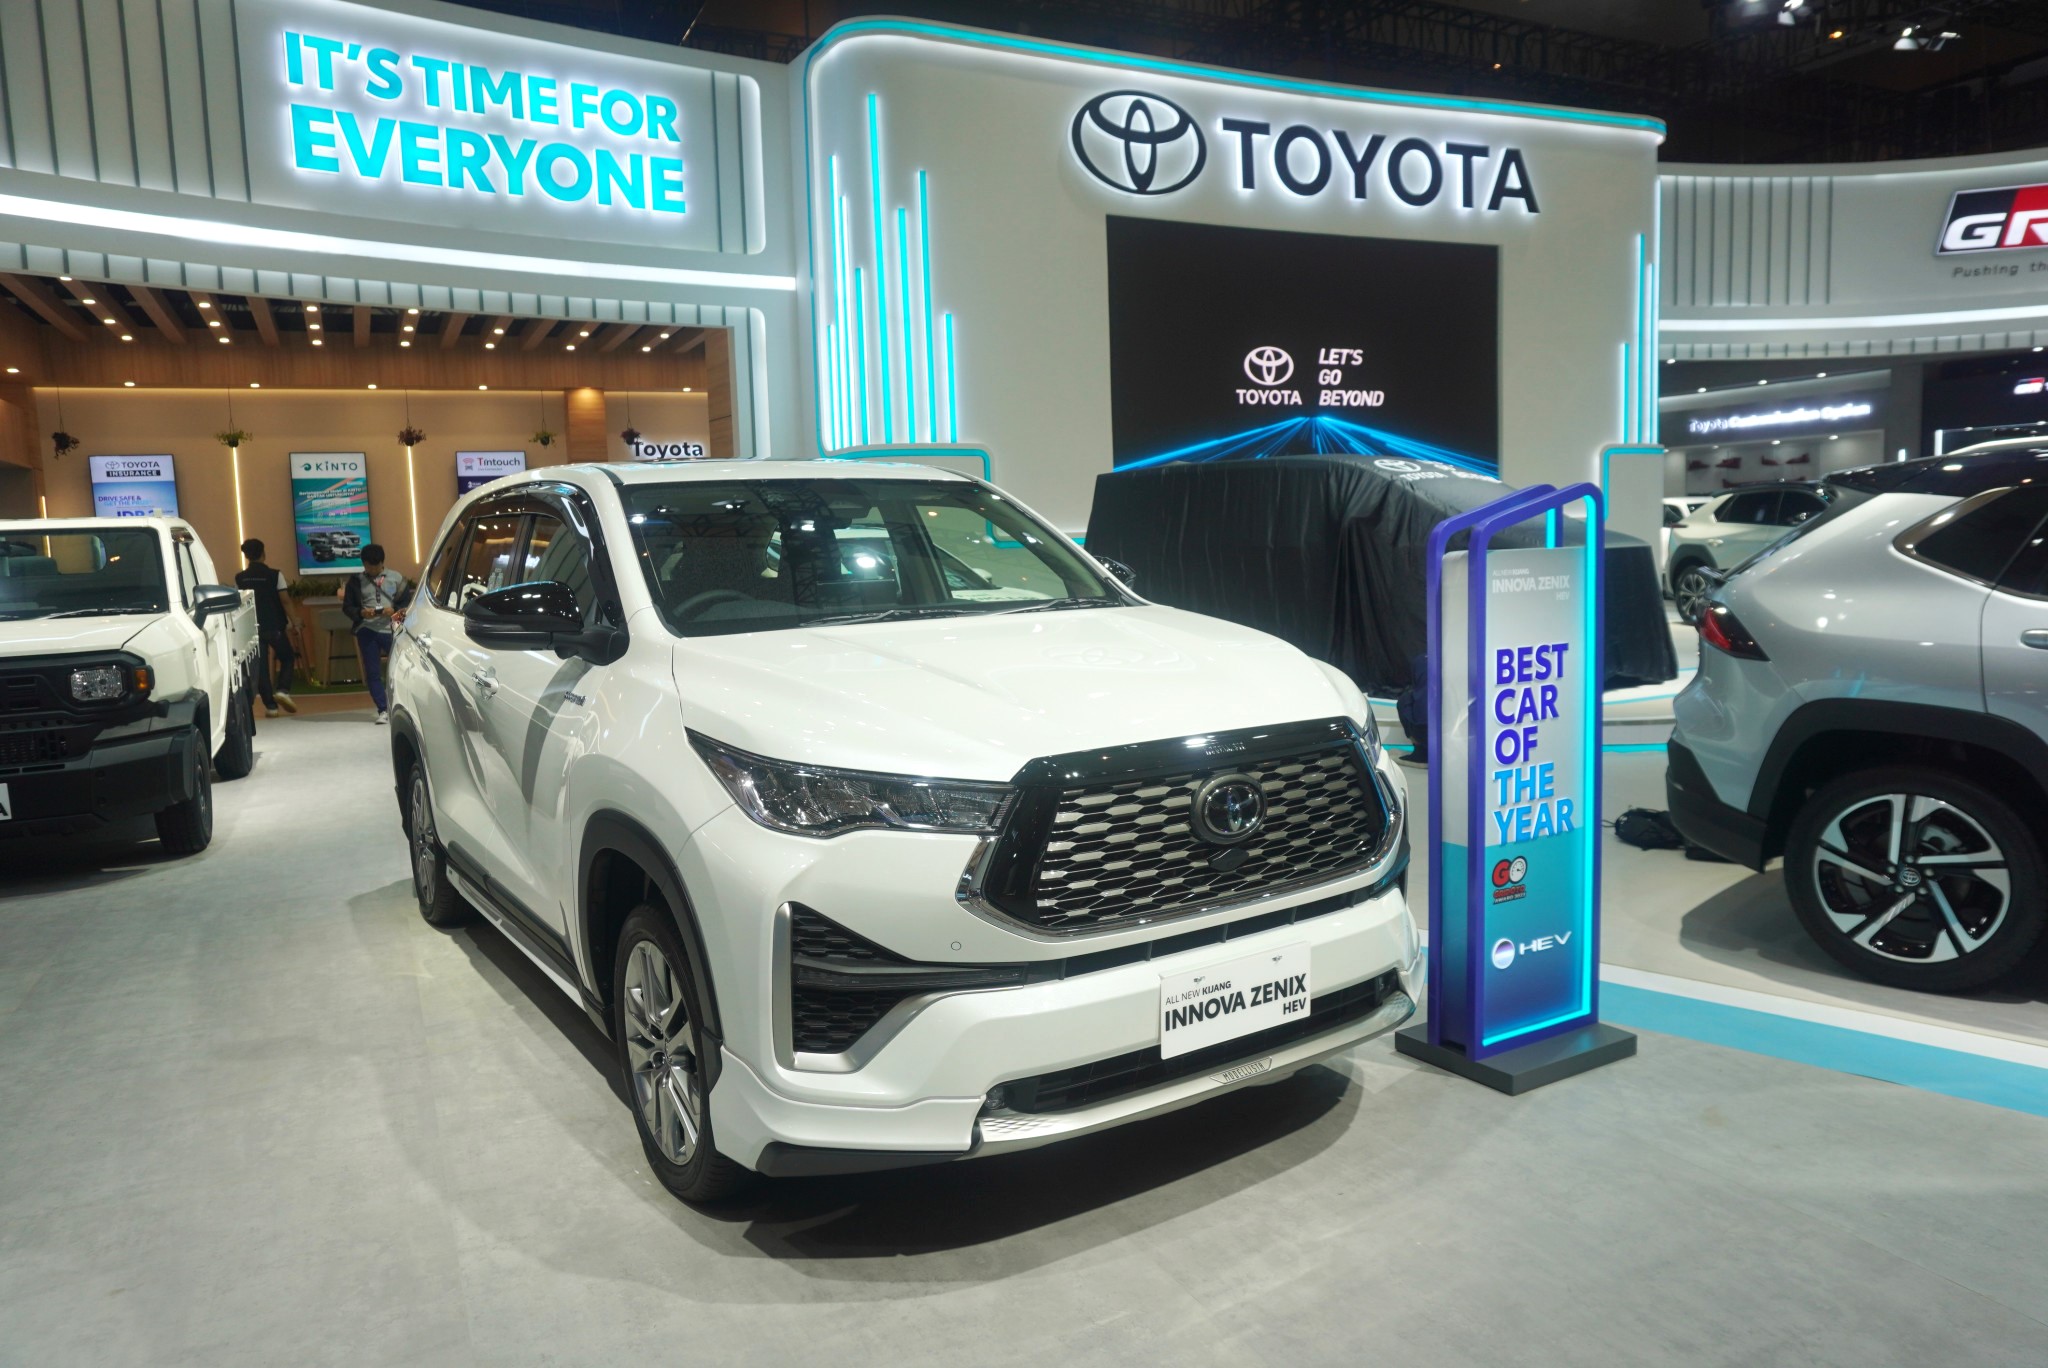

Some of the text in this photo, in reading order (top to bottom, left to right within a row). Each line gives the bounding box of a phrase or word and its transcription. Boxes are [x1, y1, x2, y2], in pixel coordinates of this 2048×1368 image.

[284, 31, 681, 142] IT'S TIME FOR
[289, 104, 686, 213] EVERYONE
[1220, 117, 1541, 214] TOYOTA
[1953, 261, 2048, 278] Pushing th
[1318, 348, 1364, 366] LET'S
[1318, 368, 1342, 386] GO
[1236, 389, 1303, 405] TOYOTA
[1318, 389, 1385, 407] BEYOND
[634, 441, 703, 459] Toyota
[1492, 575, 1570, 593] INNOVA ZENIX
[1496, 643, 1569, 685] BEST
[1494, 684, 1559, 725] CAR
[1494, 726, 1538, 766] OF
[1494, 762, 1555, 806] THE
[1494, 798, 1574, 846] YEAR
[1519, 931, 1572, 955] HEV
[1165, 981, 1232, 1005] ALL NEW KIJANG
[1165, 973, 1307, 1032] INNOVA ZENIX
[1283, 998, 1307, 1015] HEV
